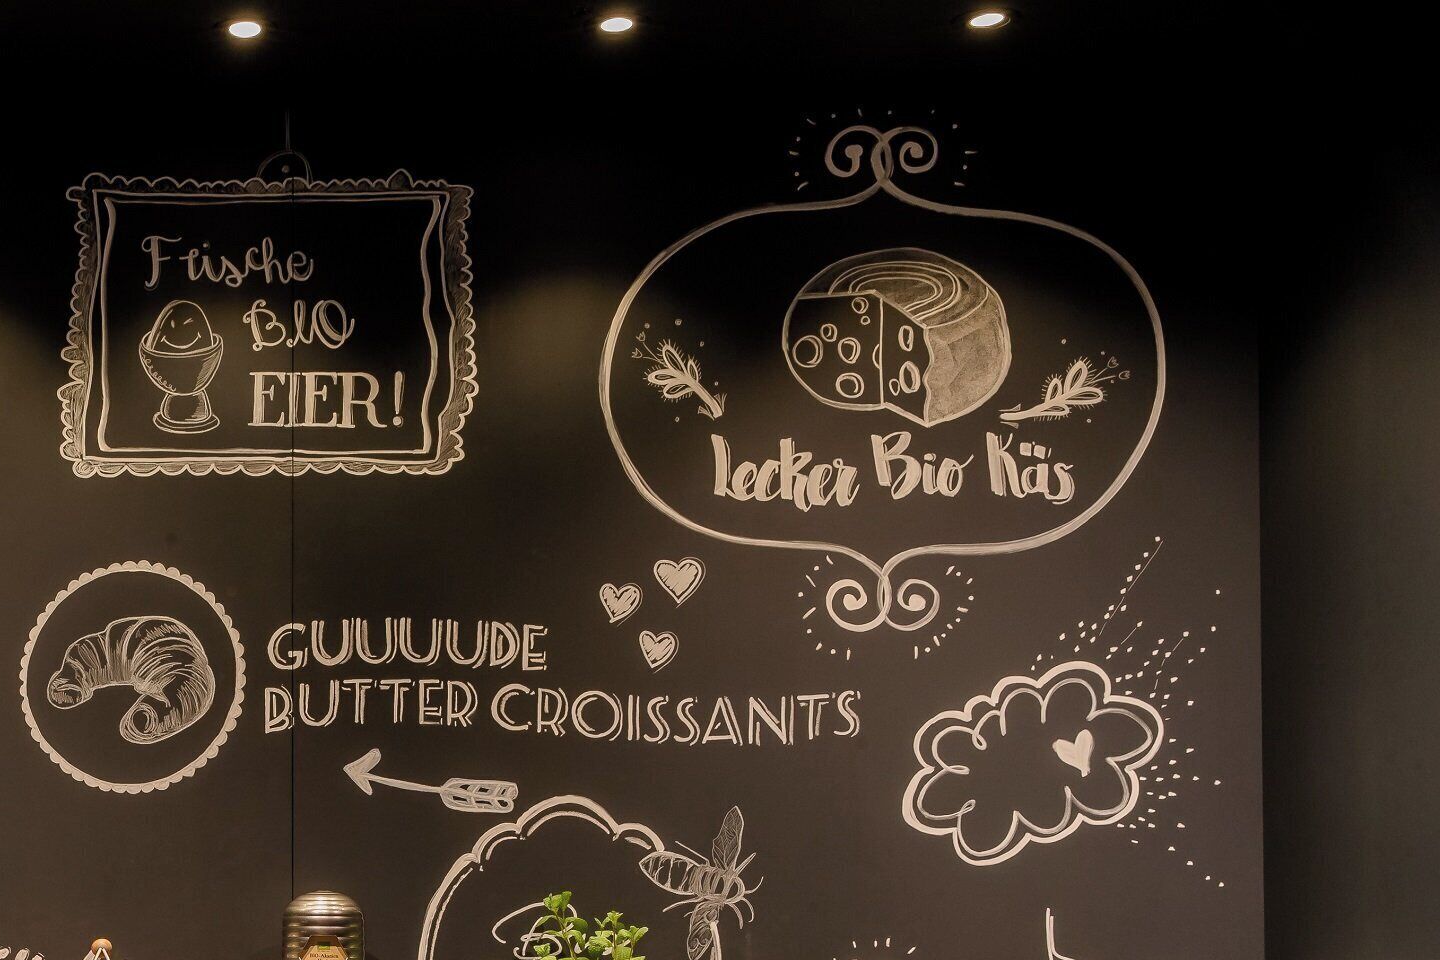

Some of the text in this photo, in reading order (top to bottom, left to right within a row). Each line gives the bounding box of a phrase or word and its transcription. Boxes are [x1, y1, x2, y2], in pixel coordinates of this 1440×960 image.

[141, 235, 314, 290] Frische
[248, 370, 407, 428] EIER!
[871, 431, 974, 500] Bio
[985, 431, 1076, 505] Käs
[266, 617, 549, 671] GUUUUDE
[263, 678, 862, 746] BUTTER CROISSANTS
